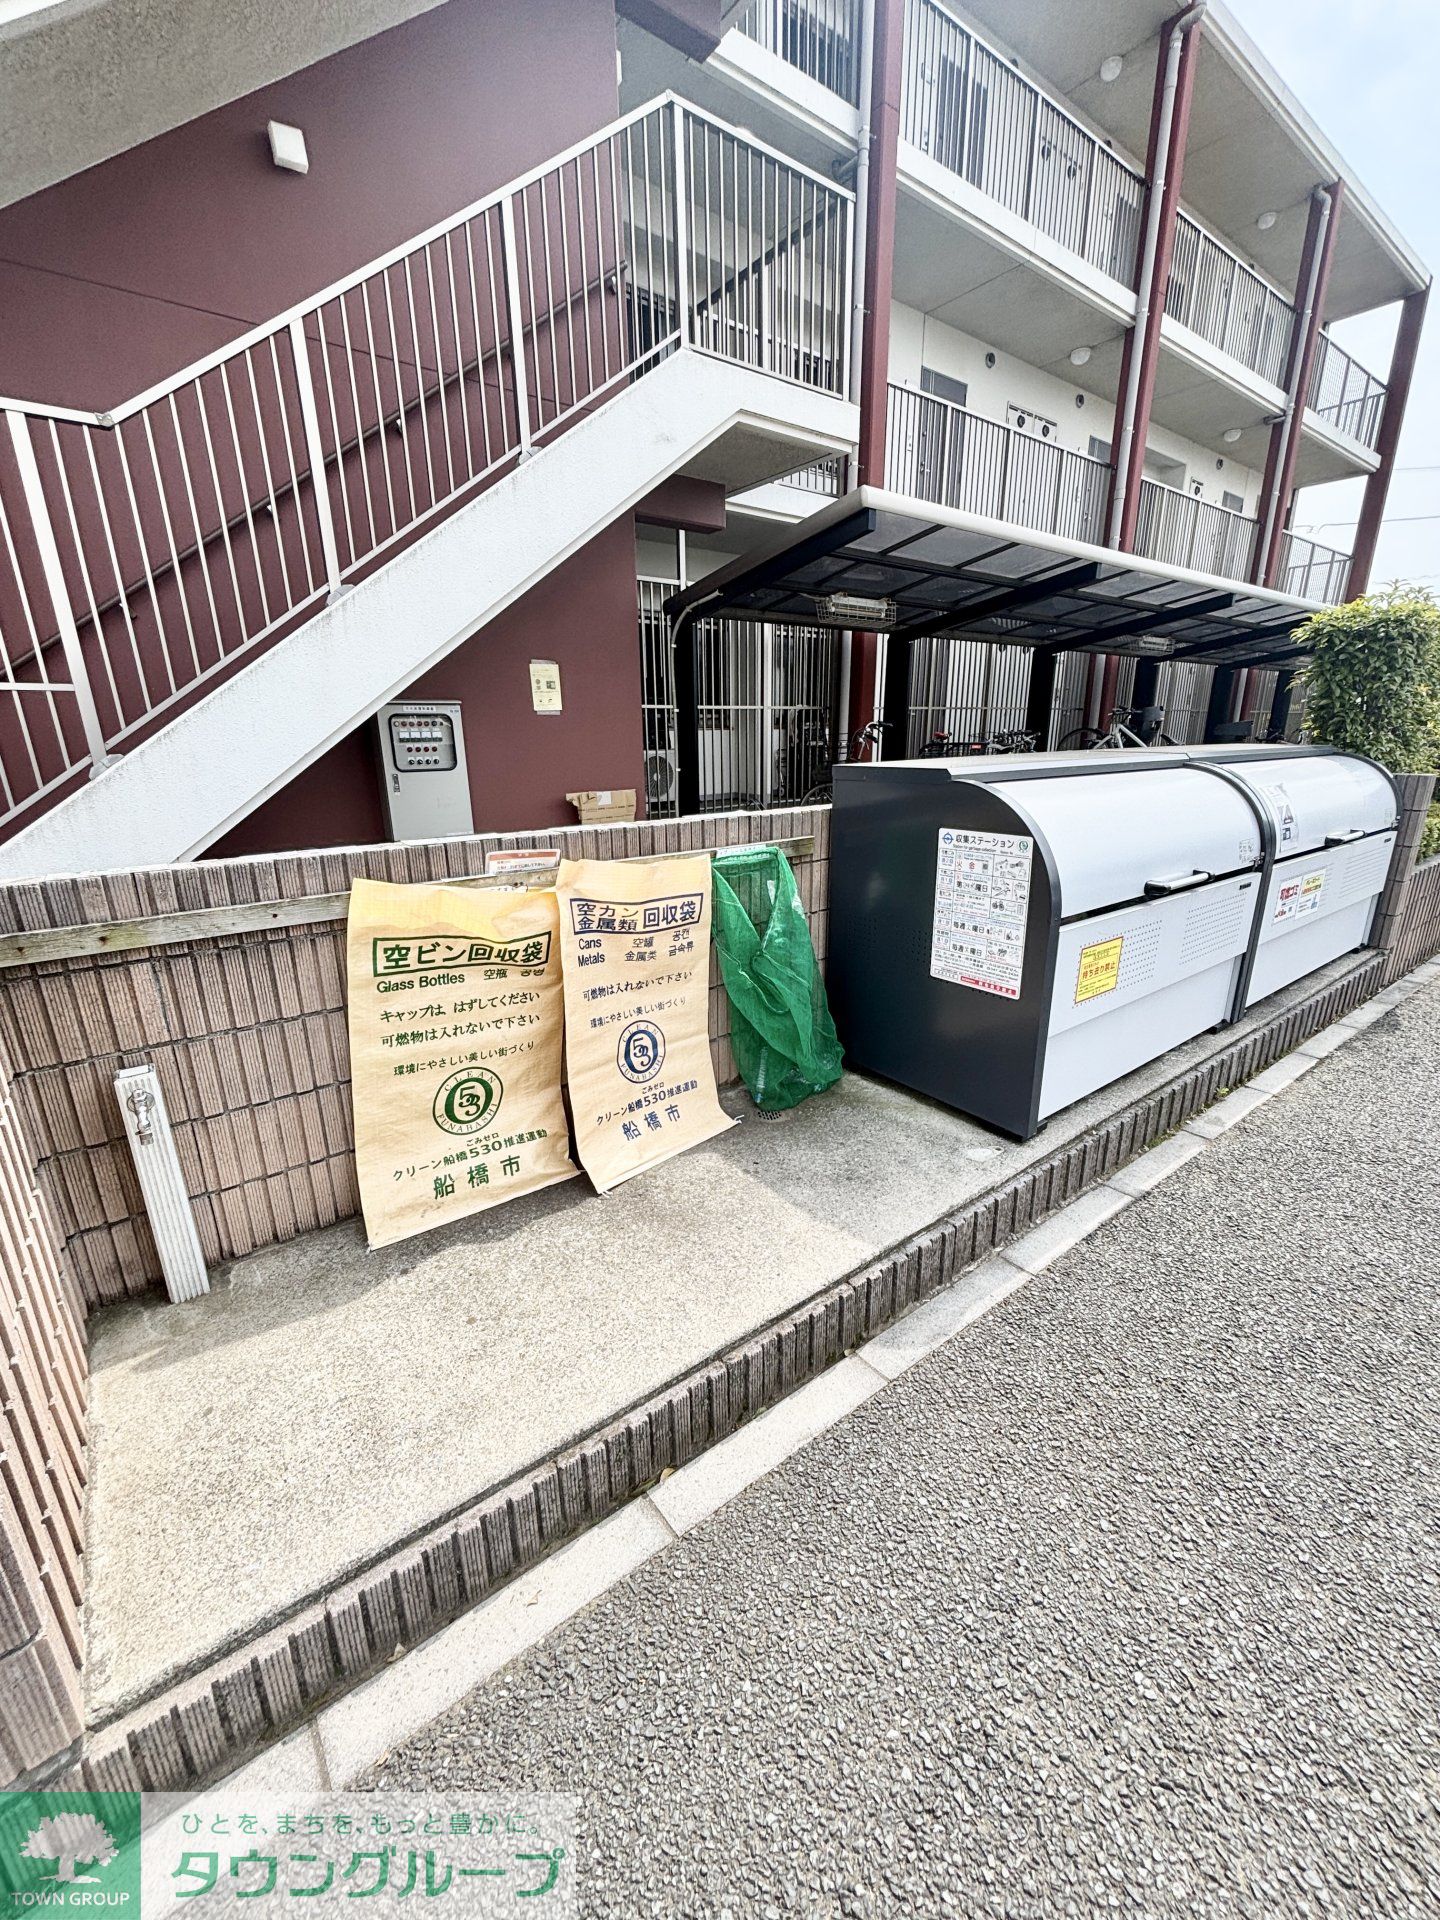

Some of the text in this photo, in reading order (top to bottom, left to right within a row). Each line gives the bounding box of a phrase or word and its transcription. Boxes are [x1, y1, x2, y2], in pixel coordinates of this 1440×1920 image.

[956, 834, 1014, 848] 収集ステーション
[577, 903, 638, 918] 空カン
[643, 901, 696, 929] 回収袋
[577, 917, 638, 931] 金属類
[579, 938, 602, 950] Cans
[383, 941, 543, 969] 空ビン回収袋
[578, 952, 605, 967] Metals
[625, 951, 657, 961] 金属类
[484, 969, 508, 980] 空瓶
[1082, 961, 1116, 979] 持ち去り禁止
[377, 973, 465, 993] Glass Bottles
[583, 971, 692, 1002] 可燃物は入れないで下さい
[590, 996, 686, 1028] 環境にやさしい美しい街づくり
[380, 1013, 541, 1048] 可燃物は入れないで下さい
[393, 1041, 534, 1076] 環境にやさしい美しい街づくり
[444, 1070, 497, 1092] CLEAN
[642, 1081, 665, 1095] ごみゼロ
[466, 1132, 499, 1147] ごみゼロ
